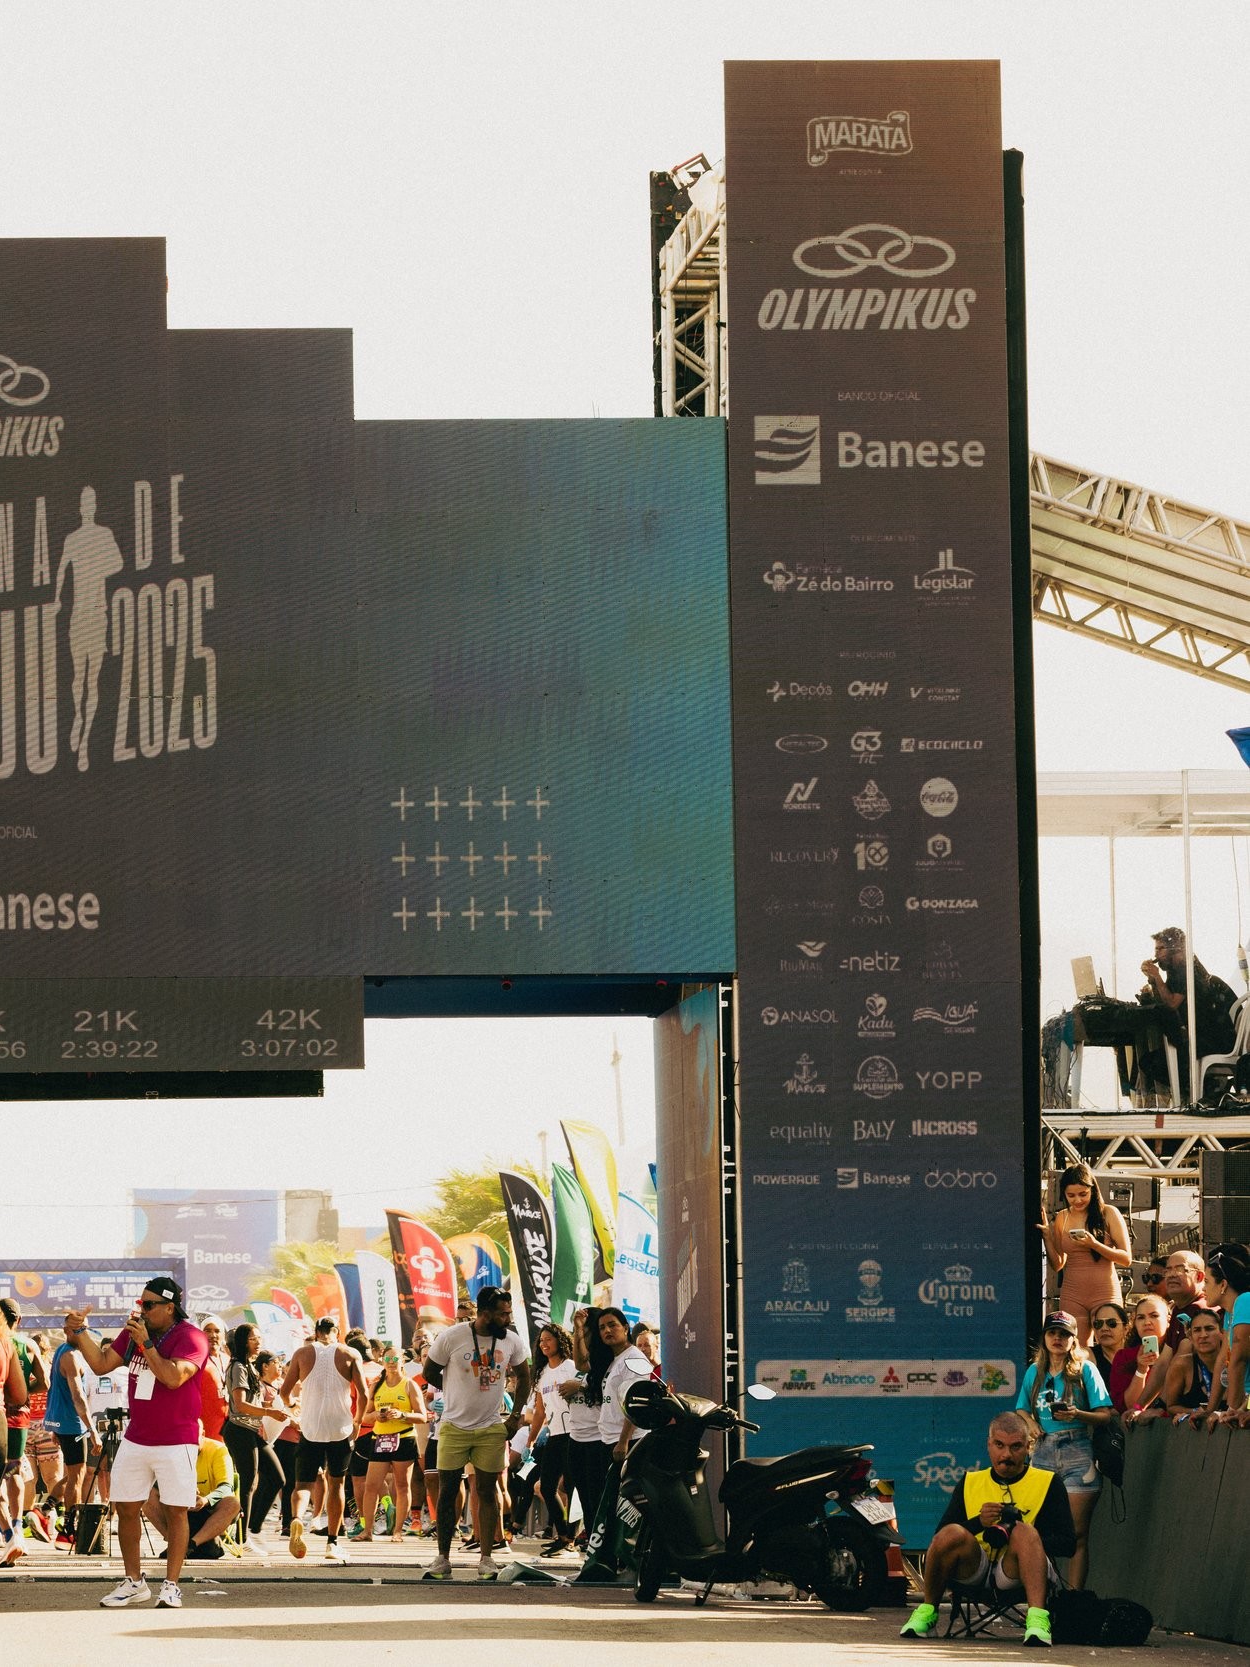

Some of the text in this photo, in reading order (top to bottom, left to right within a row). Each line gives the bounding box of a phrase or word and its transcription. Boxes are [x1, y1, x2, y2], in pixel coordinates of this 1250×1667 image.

[757, 288, 976, 331] OLYMPIKUS
[837, 391, 921, 402] BANCO OFICIAL
[838, 432, 985, 468] Banese
[134, 473, 186, 571] DE
[796, 576, 894, 592] Zé do Bairro
[914, 575, 974, 594] Legislar
[111, 574, 217, 763] 2025
[921, 899, 979, 909] GONZAGA
[74, 1010, 139, 1032] 21K
[256, 1008, 323, 1030] 42K
[780, 1010, 839, 1023] ANASOL
[858, 1015, 895, 1030] Kadu
[61, 1040, 158, 1059] 2:39:22
[241, 1038, 338, 1058] 3:07:02
[916, 1071, 983, 1089] YOPP
[770, 1121, 833, 1144] equaliv
[853, 1119, 896, 1140] BALY
[753, 1174, 821, 1185] POWERADE
[863, 1172, 911, 1185] Banese
[925, 1169, 997, 1188] dobro
[193, 1249, 252, 1264] Banese
[918, 1279, 997, 1307] Corona
[377, 1279, 387, 1336] Banese
[764, 1300, 830, 1312] ARACAJU
[845, 1308, 895, 1317] SERGIPE
[945, 1304, 974, 1317] Cero
